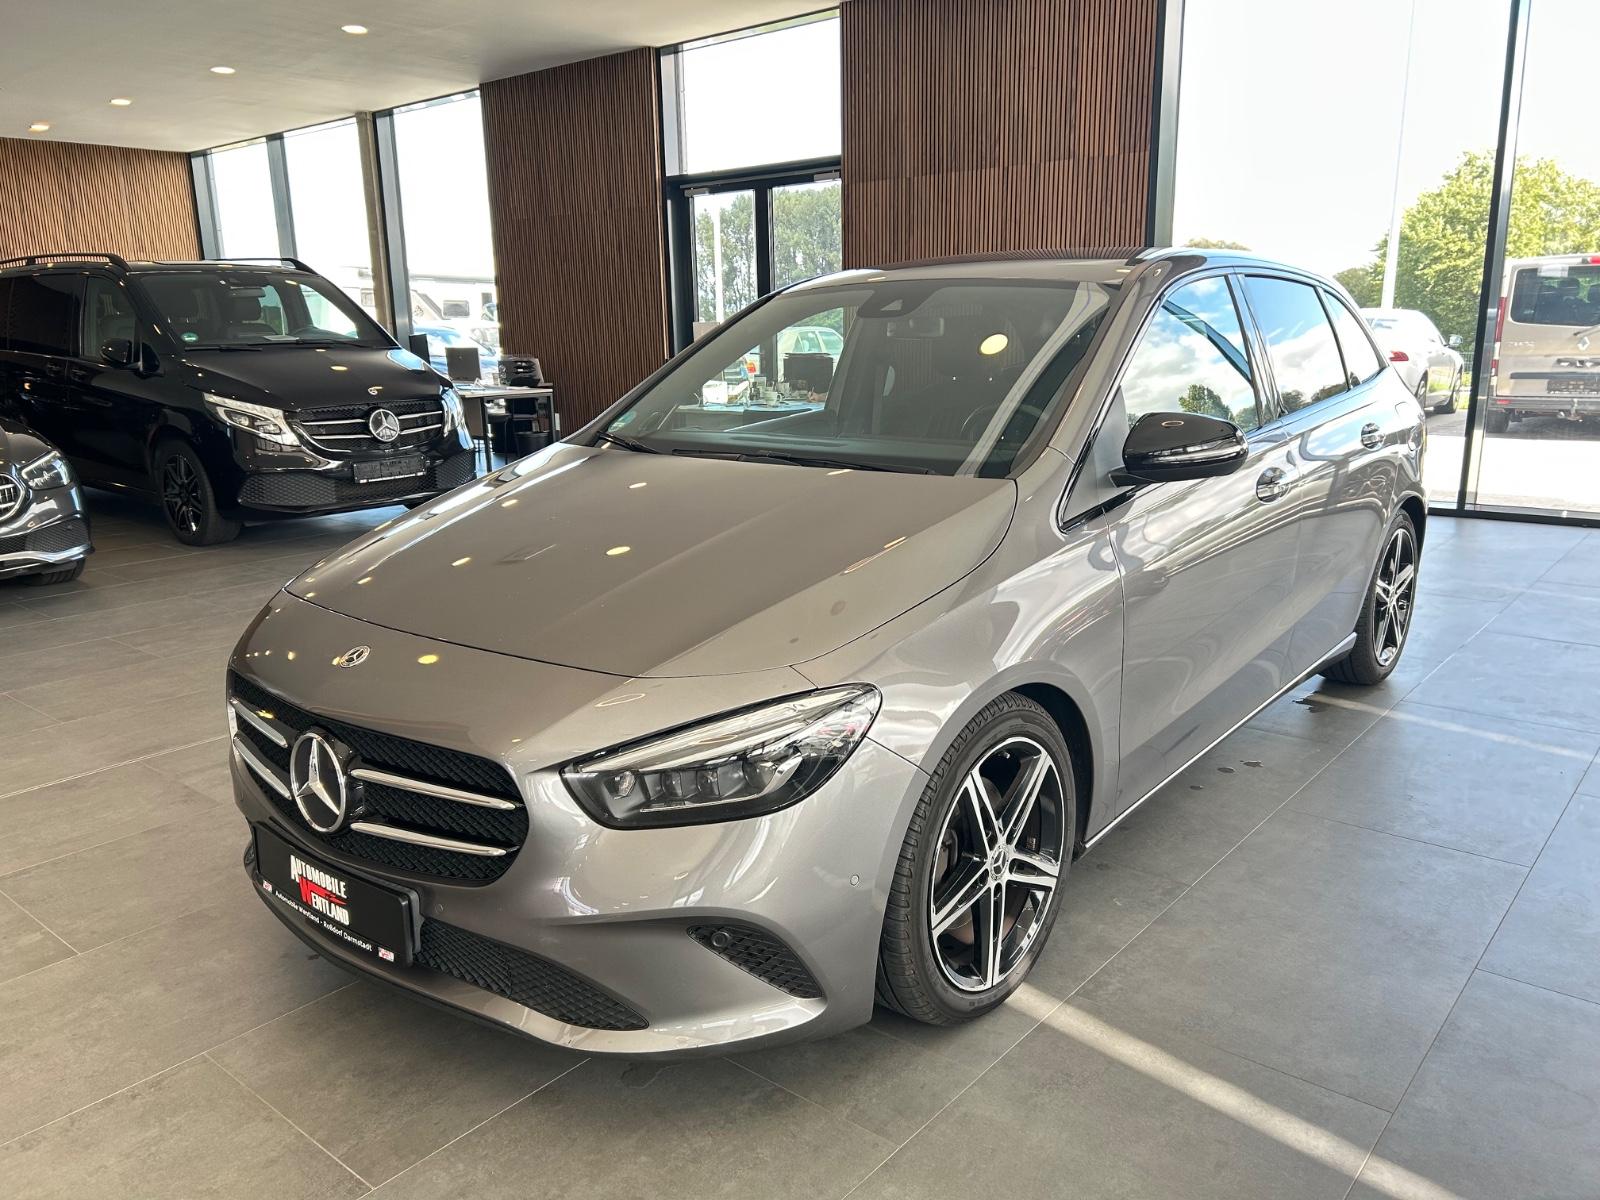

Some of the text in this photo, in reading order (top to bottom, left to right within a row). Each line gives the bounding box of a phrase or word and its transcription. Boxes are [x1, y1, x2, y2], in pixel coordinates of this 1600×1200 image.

[290, 854, 347, 899] AUTOMOBILE
[298, 876, 350, 926] WENTLAND
[275, 890, 299, 911] Automobile
[299, 906, 320, 924] Wentland
[343, 932, 373, 952] Darmstadt
